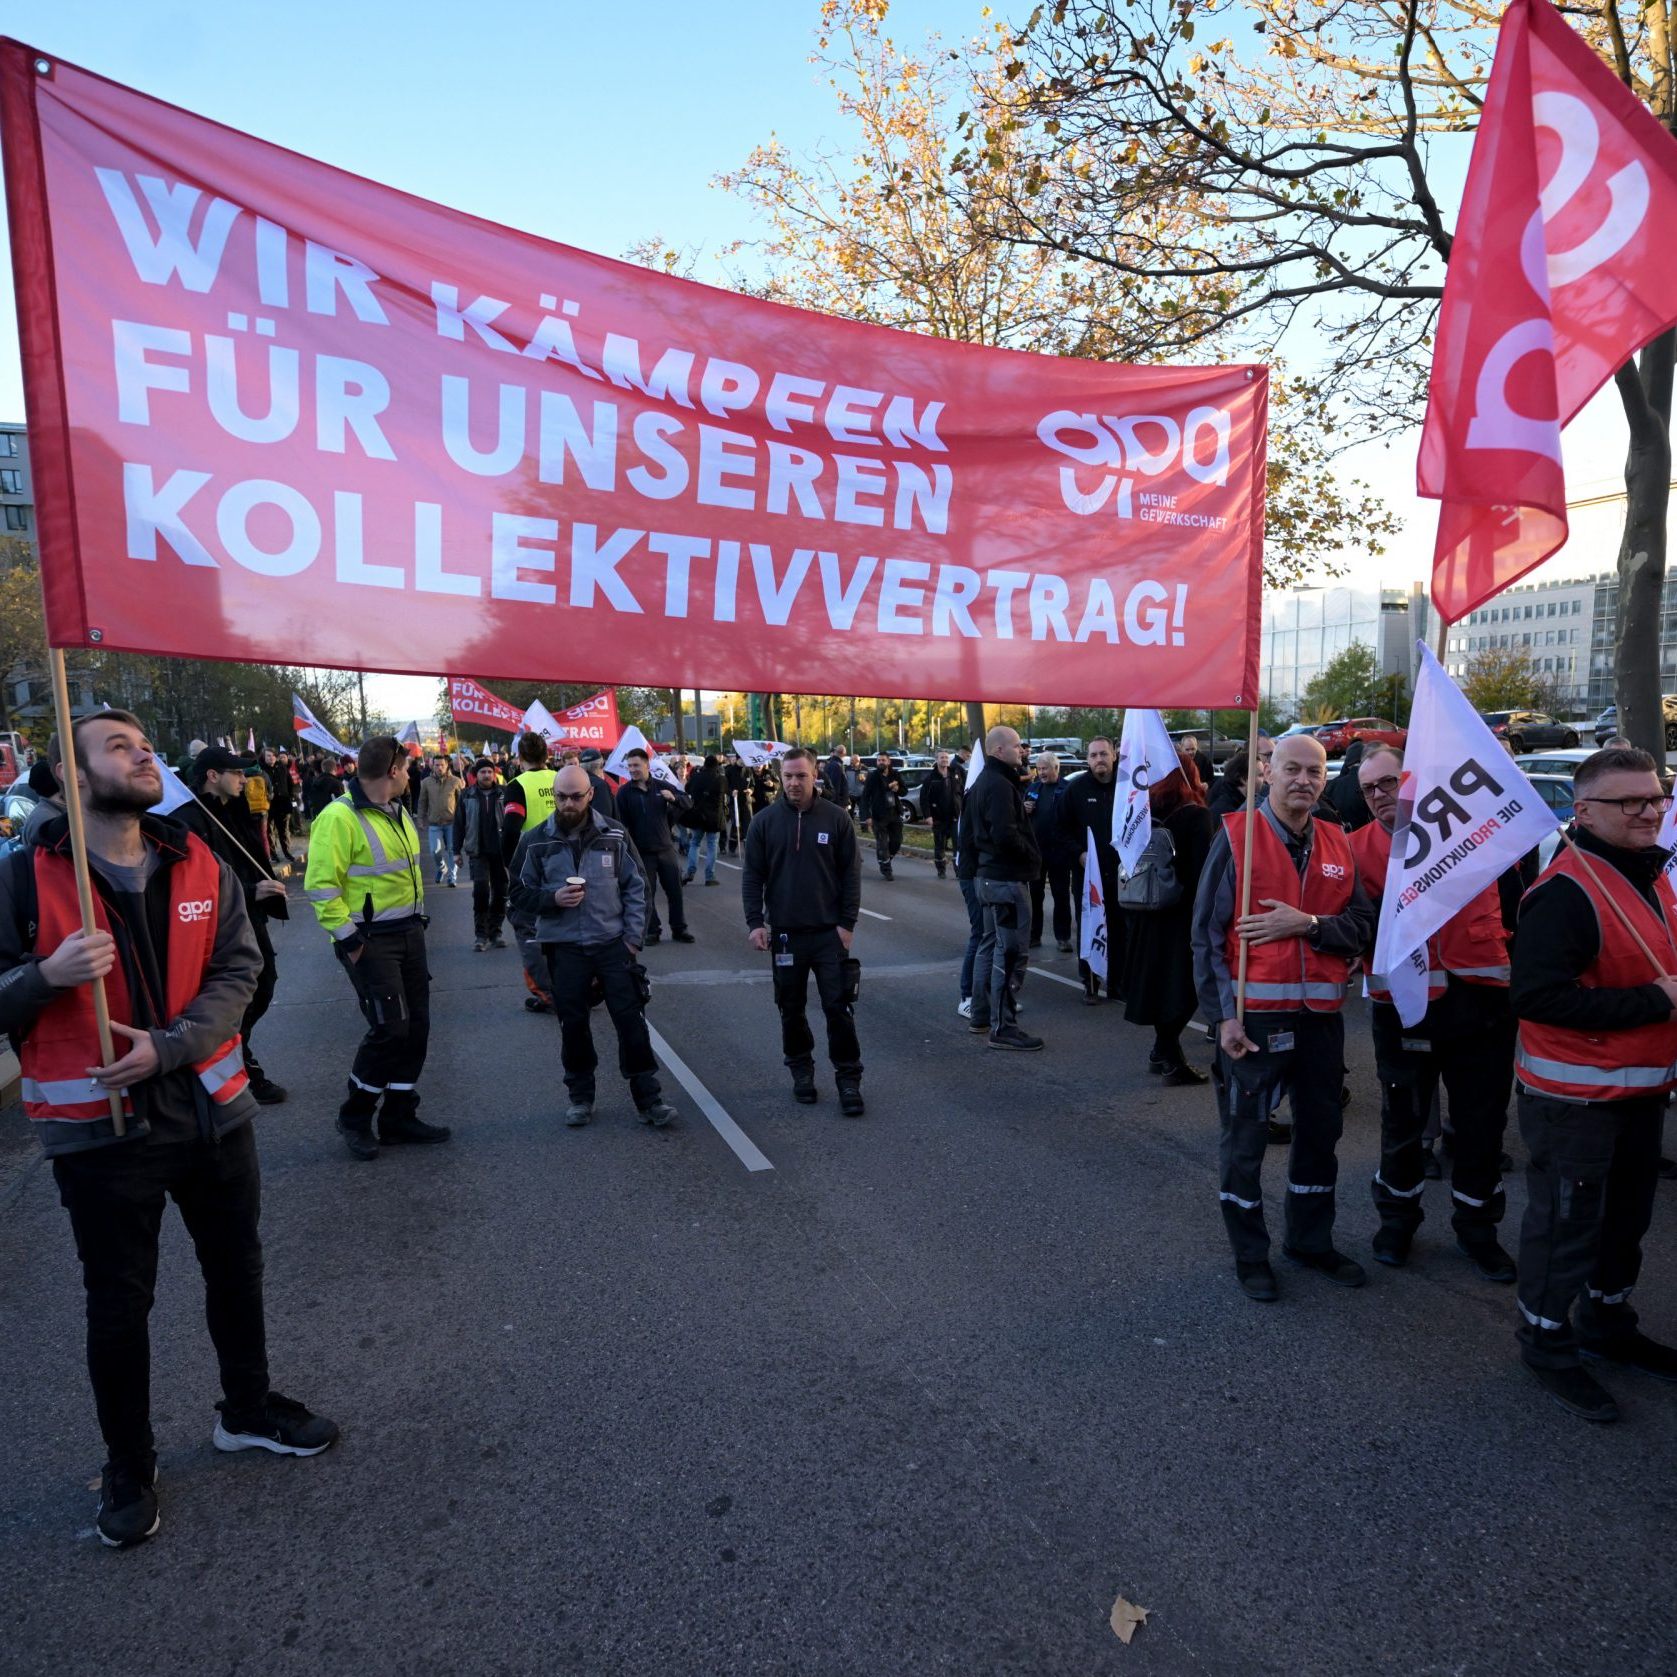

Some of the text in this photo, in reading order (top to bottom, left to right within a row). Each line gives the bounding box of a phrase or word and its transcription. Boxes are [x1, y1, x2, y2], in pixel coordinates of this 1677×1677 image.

[93, 166, 950, 452] WIR KÄMPFEN
[112, 311, 954, 535] FÜR UNSEREN
[1036, 406, 1231, 520] gpa
[123, 462, 1188, 647] KOLLEKTIVVERTRAG!
[1139, 492, 1178, 509] MEINE
[1139, 508, 1228, 530] GEWERKSCHAFT
[178, 900, 213, 923] gpa
